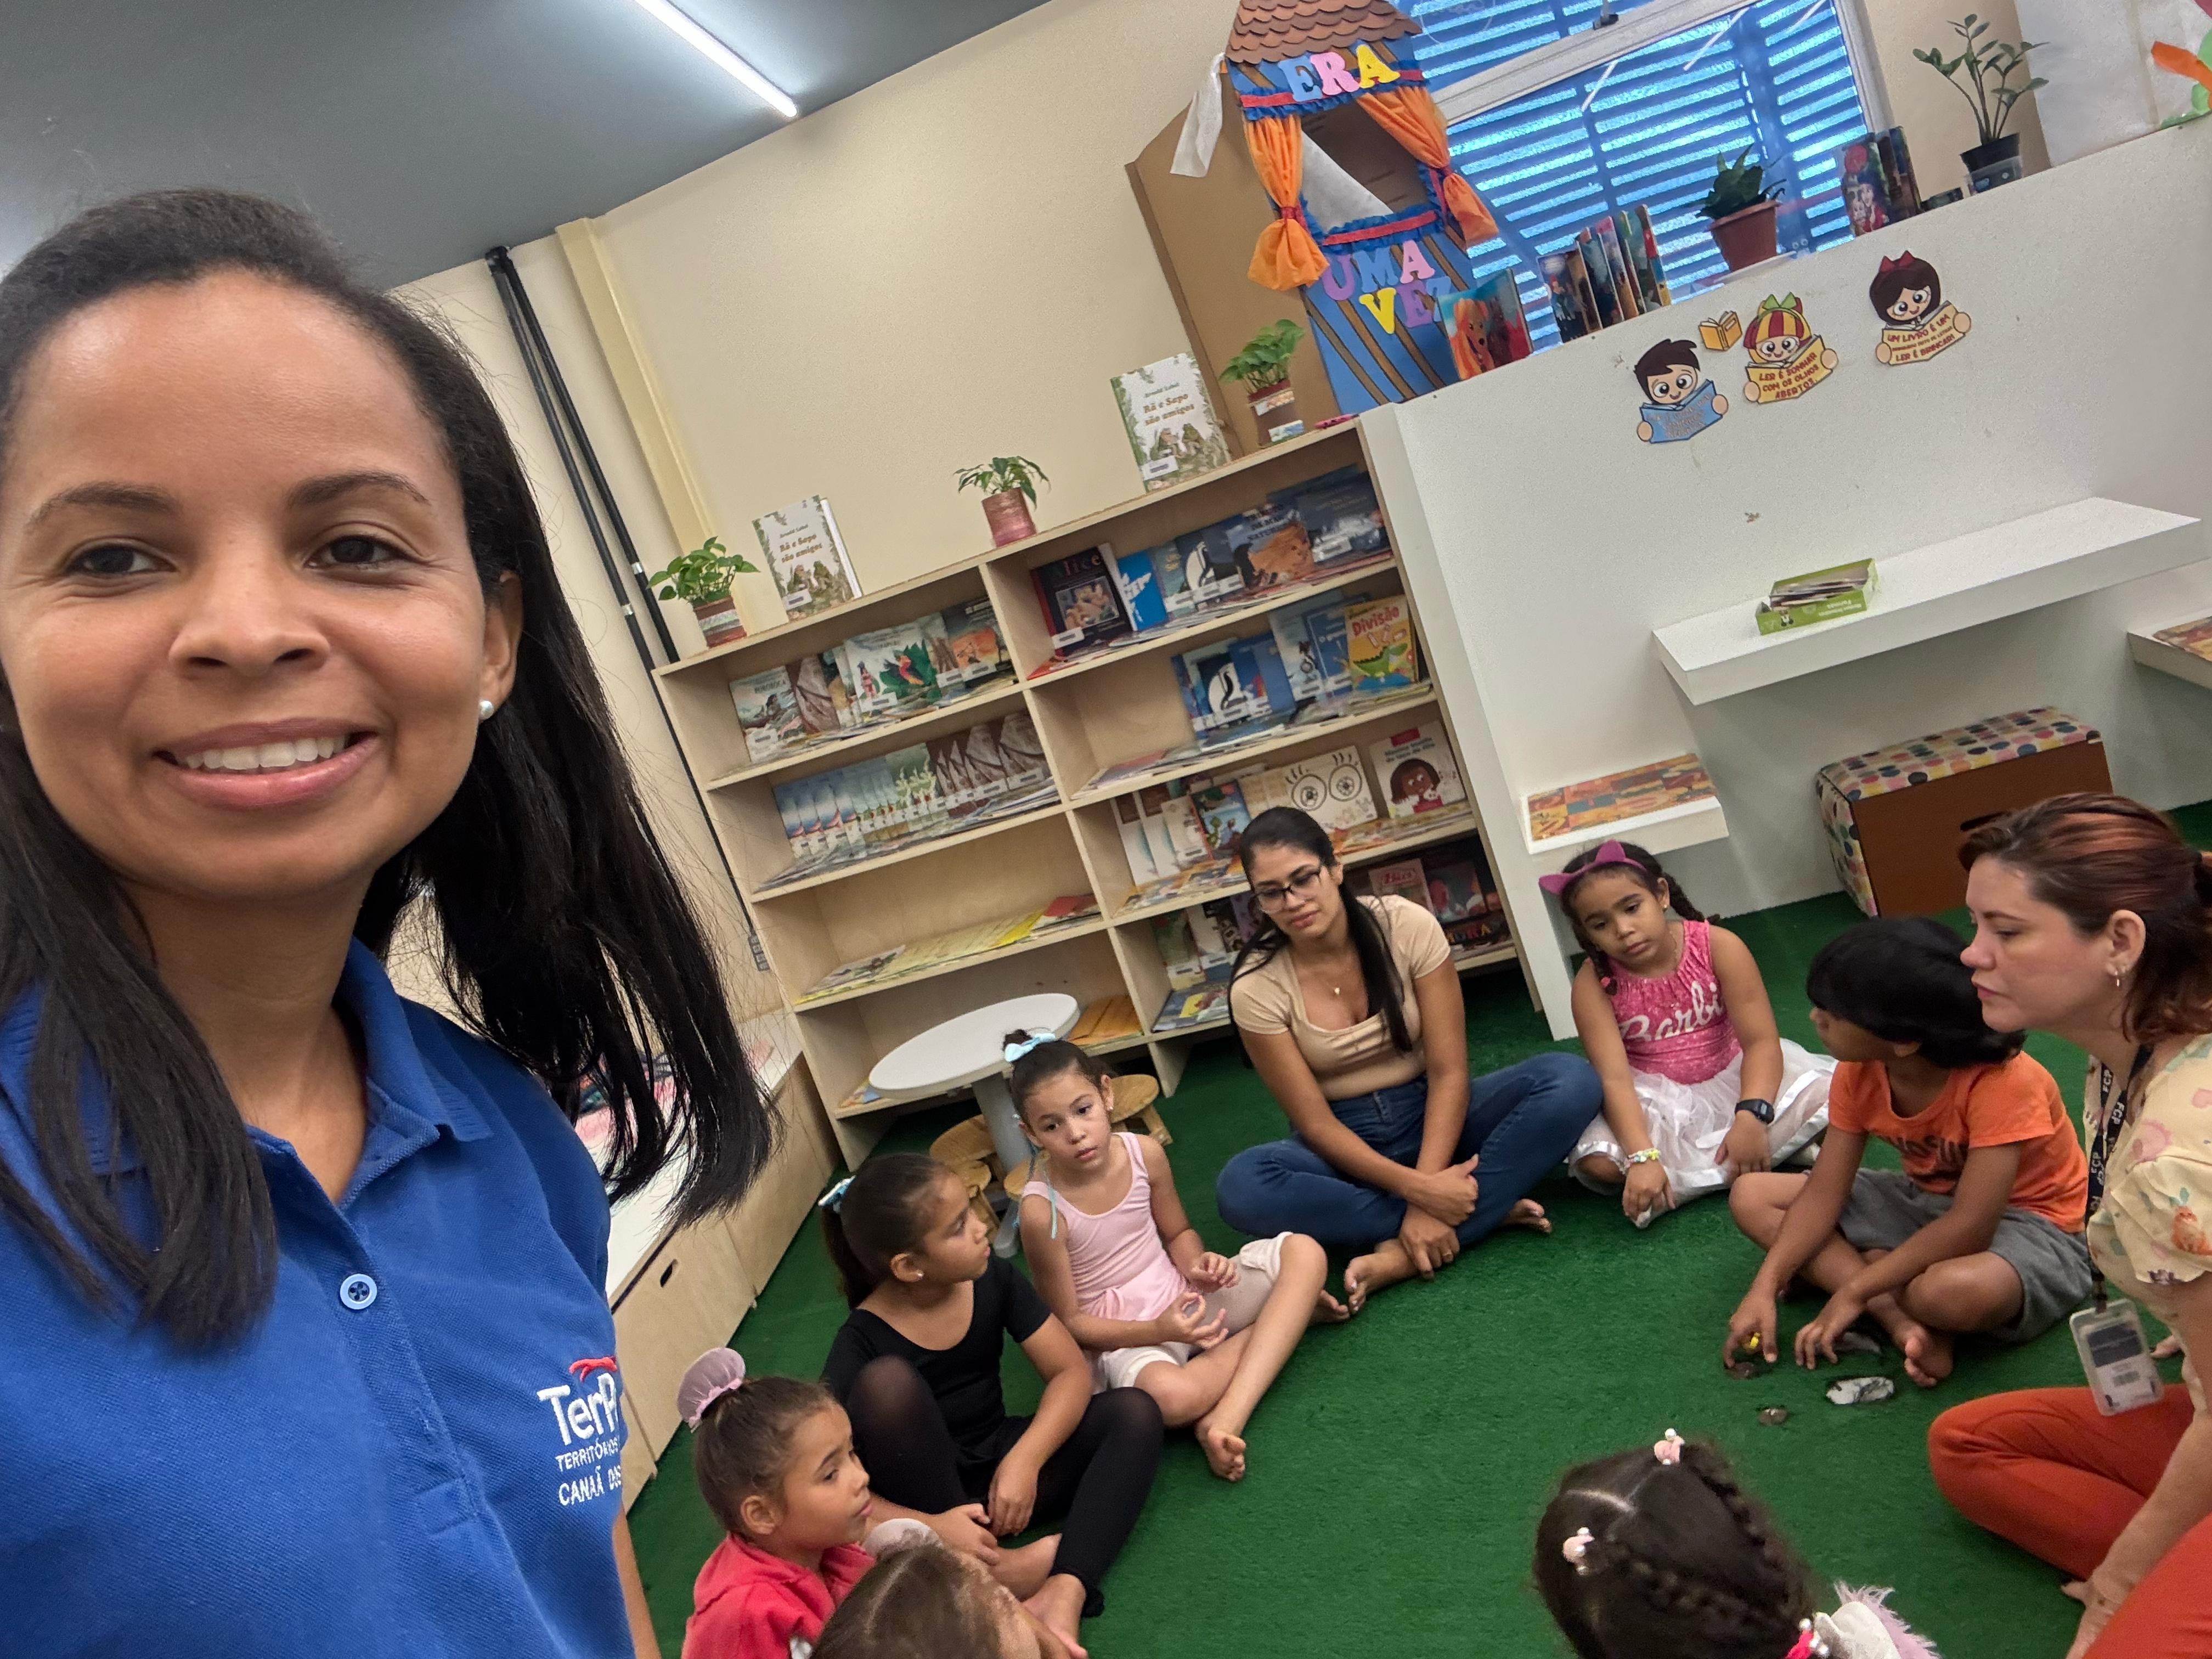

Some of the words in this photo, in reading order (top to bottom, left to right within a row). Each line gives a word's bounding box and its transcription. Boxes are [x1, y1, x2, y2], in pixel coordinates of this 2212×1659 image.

[1278, 44, 1400, 102] ERA
[1322, 240, 1435, 301] UMA
[1903, 329, 1929, 342] LIVRO
[1937, 314, 1950, 326] UM
[1895, 353, 1911, 362] LER
[1920, 334, 1955, 356] BRINCAR
[1759, 373, 1775, 381] LER
[1786, 352, 1818, 376] SONHAR
[1762, 382, 1780, 392] COM
[1782, 378, 1792, 387] OS
[1795, 364, 1819, 382] OLHOS
[1166, 393, 1189, 405] Sapo
[1352, 606, 1400, 637] Divisão
[1619, 980, 1723, 1041] Barbi
[2112, 1102, 2125, 1125] FCP
[537, 1373, 618, 1446] TerP
[558, 1465, 605, 1506] CANAÃ
